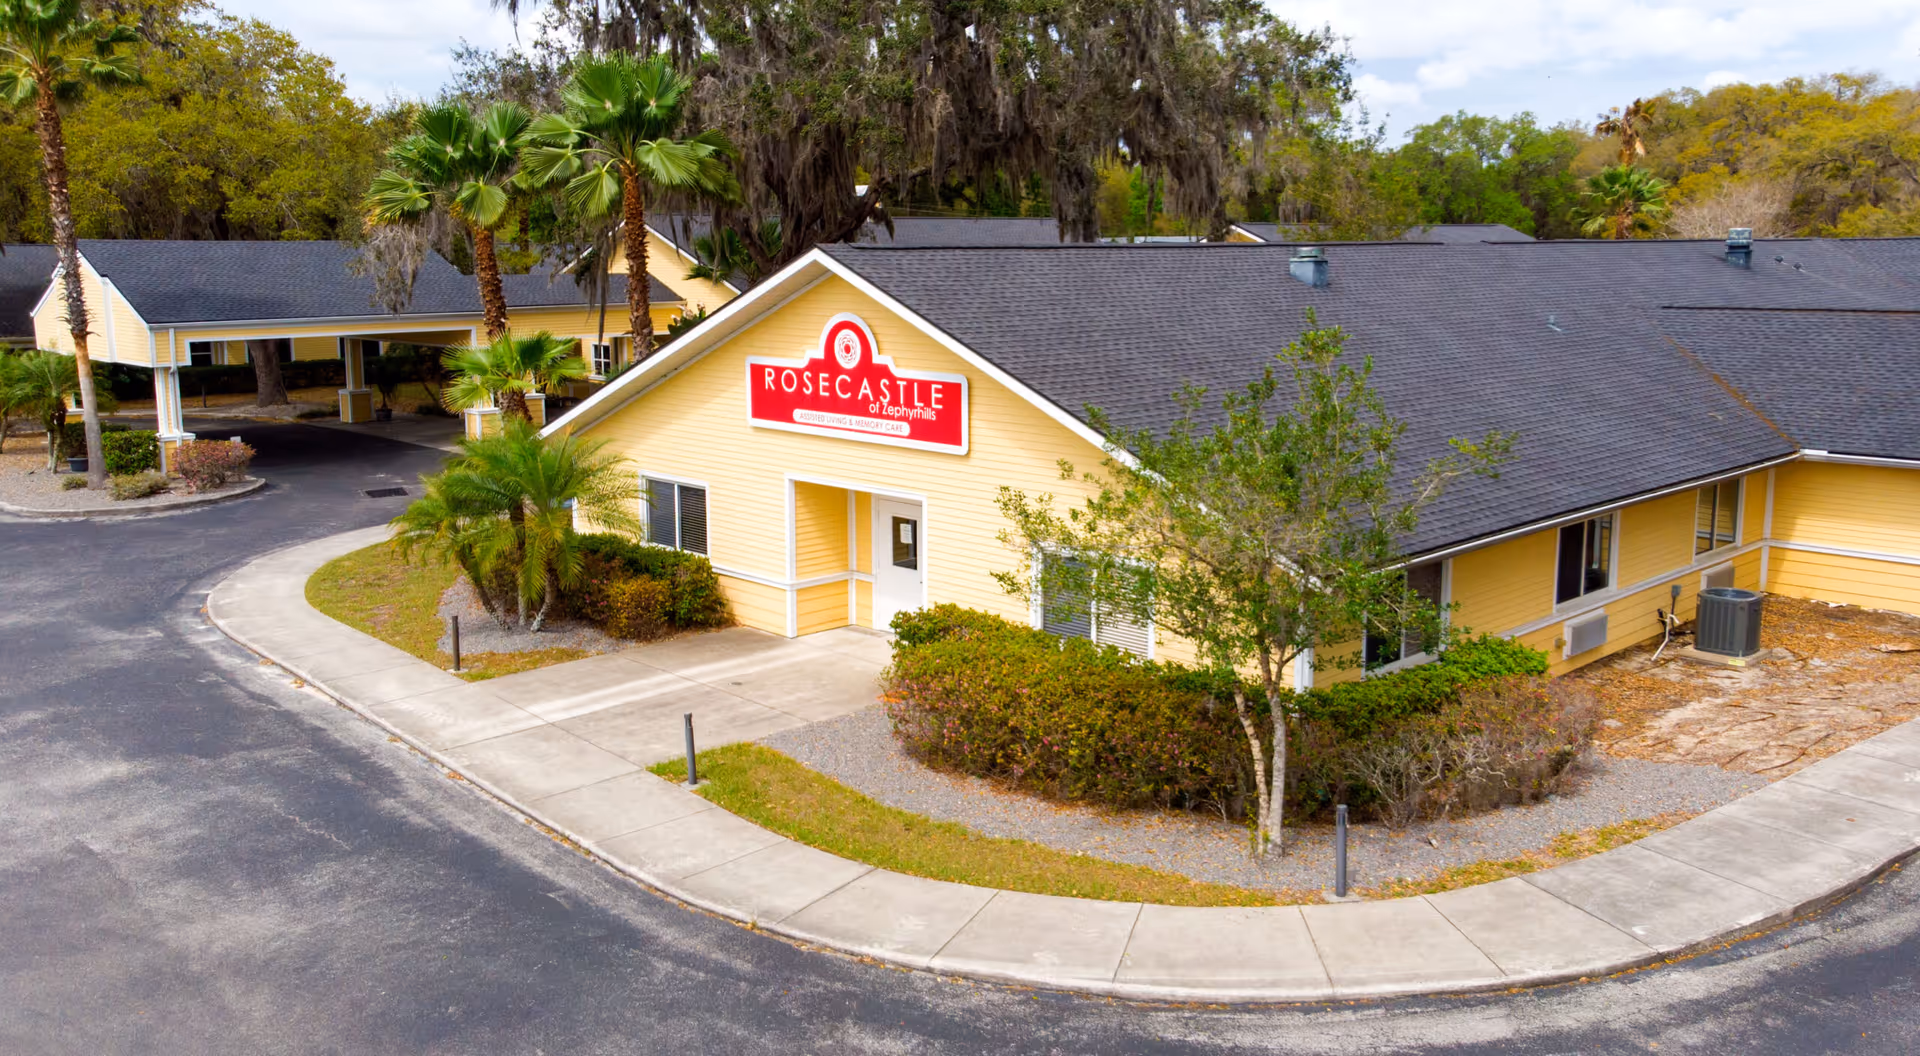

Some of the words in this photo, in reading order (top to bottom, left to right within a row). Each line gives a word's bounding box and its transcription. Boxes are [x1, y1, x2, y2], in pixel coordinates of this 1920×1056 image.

[765, 368, 943, 409] ROSECASTLE
[869, 401, 880, 414] of
[882, 402, 936, 421] Zephyrhills
[826, 415, 847, 426] LIVING
[855, 419, 883, 430] MEMORY
[885, 423, 904, 433] CARE
